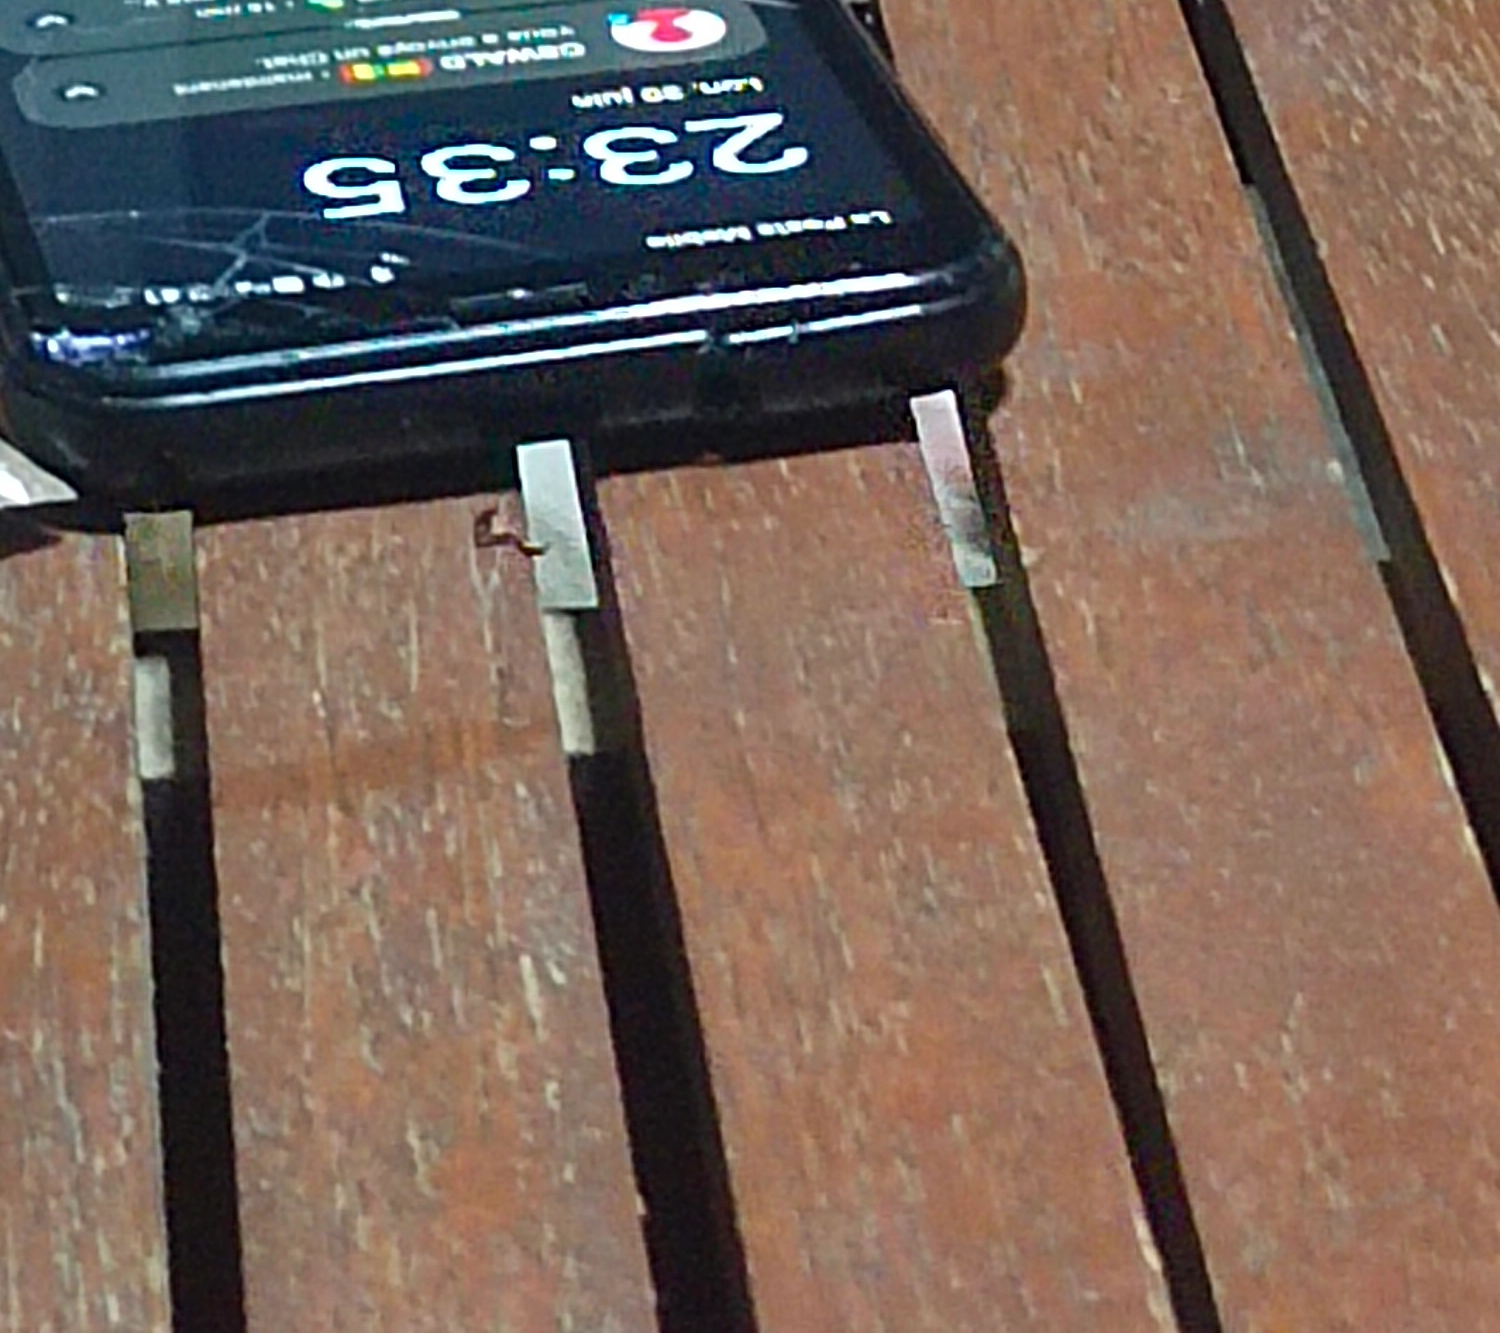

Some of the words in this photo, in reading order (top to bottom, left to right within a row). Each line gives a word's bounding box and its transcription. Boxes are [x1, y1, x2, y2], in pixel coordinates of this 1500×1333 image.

[571, 86, 635, 109] juin
[303, 112, 809, 220] 23:35
[645, 225, 753, 249] Mobile
